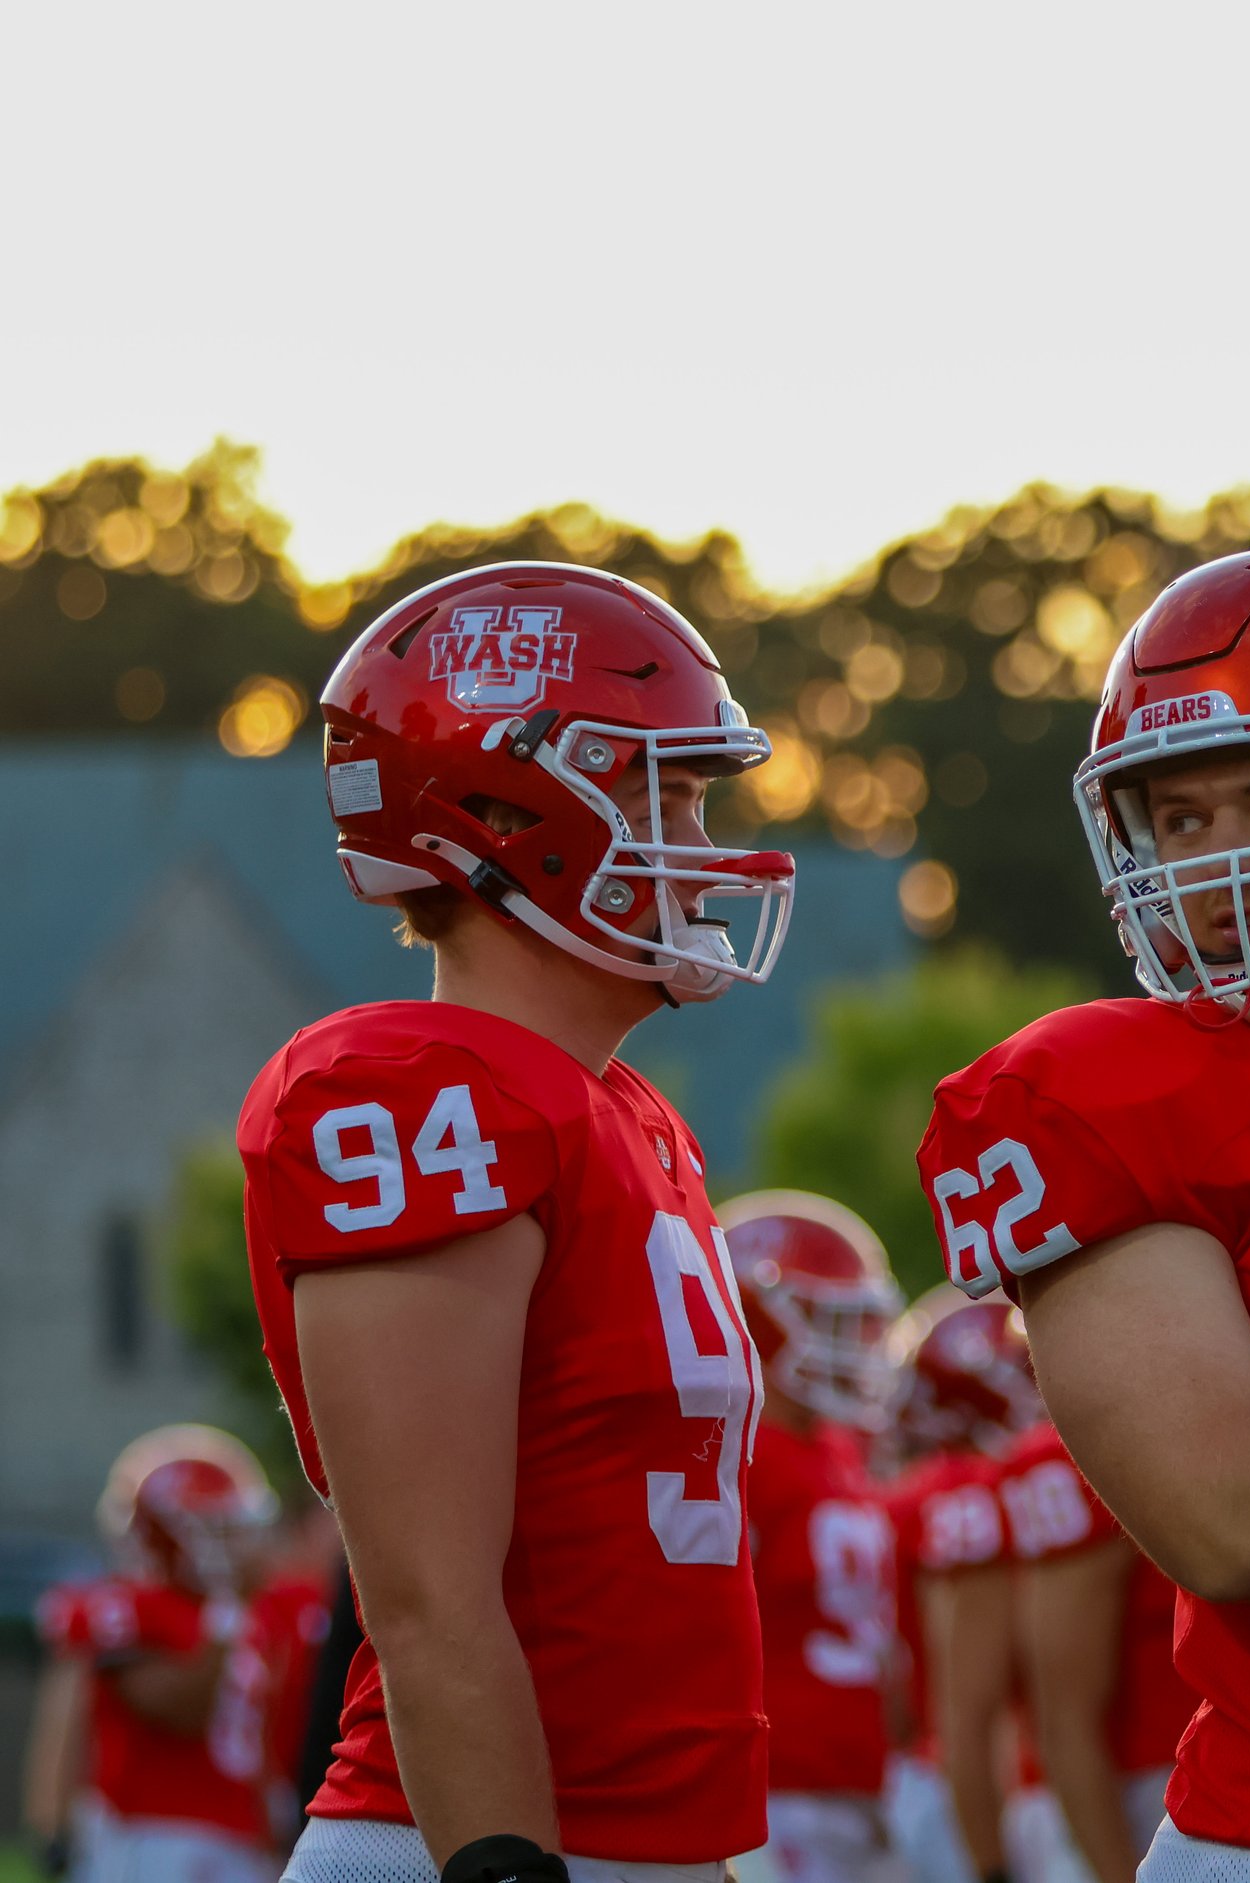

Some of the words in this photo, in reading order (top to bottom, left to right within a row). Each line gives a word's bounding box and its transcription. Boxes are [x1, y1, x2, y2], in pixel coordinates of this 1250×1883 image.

[430, 633, 576, 681] WASH
[448, 607, 563, 713] U
[1141, 696, 1211, 732] BEARS
[313, 1084, 507, 1232] 94
[934, 1138, 1082, 1298] 62
[646, 1210, 765, 1564] 9
